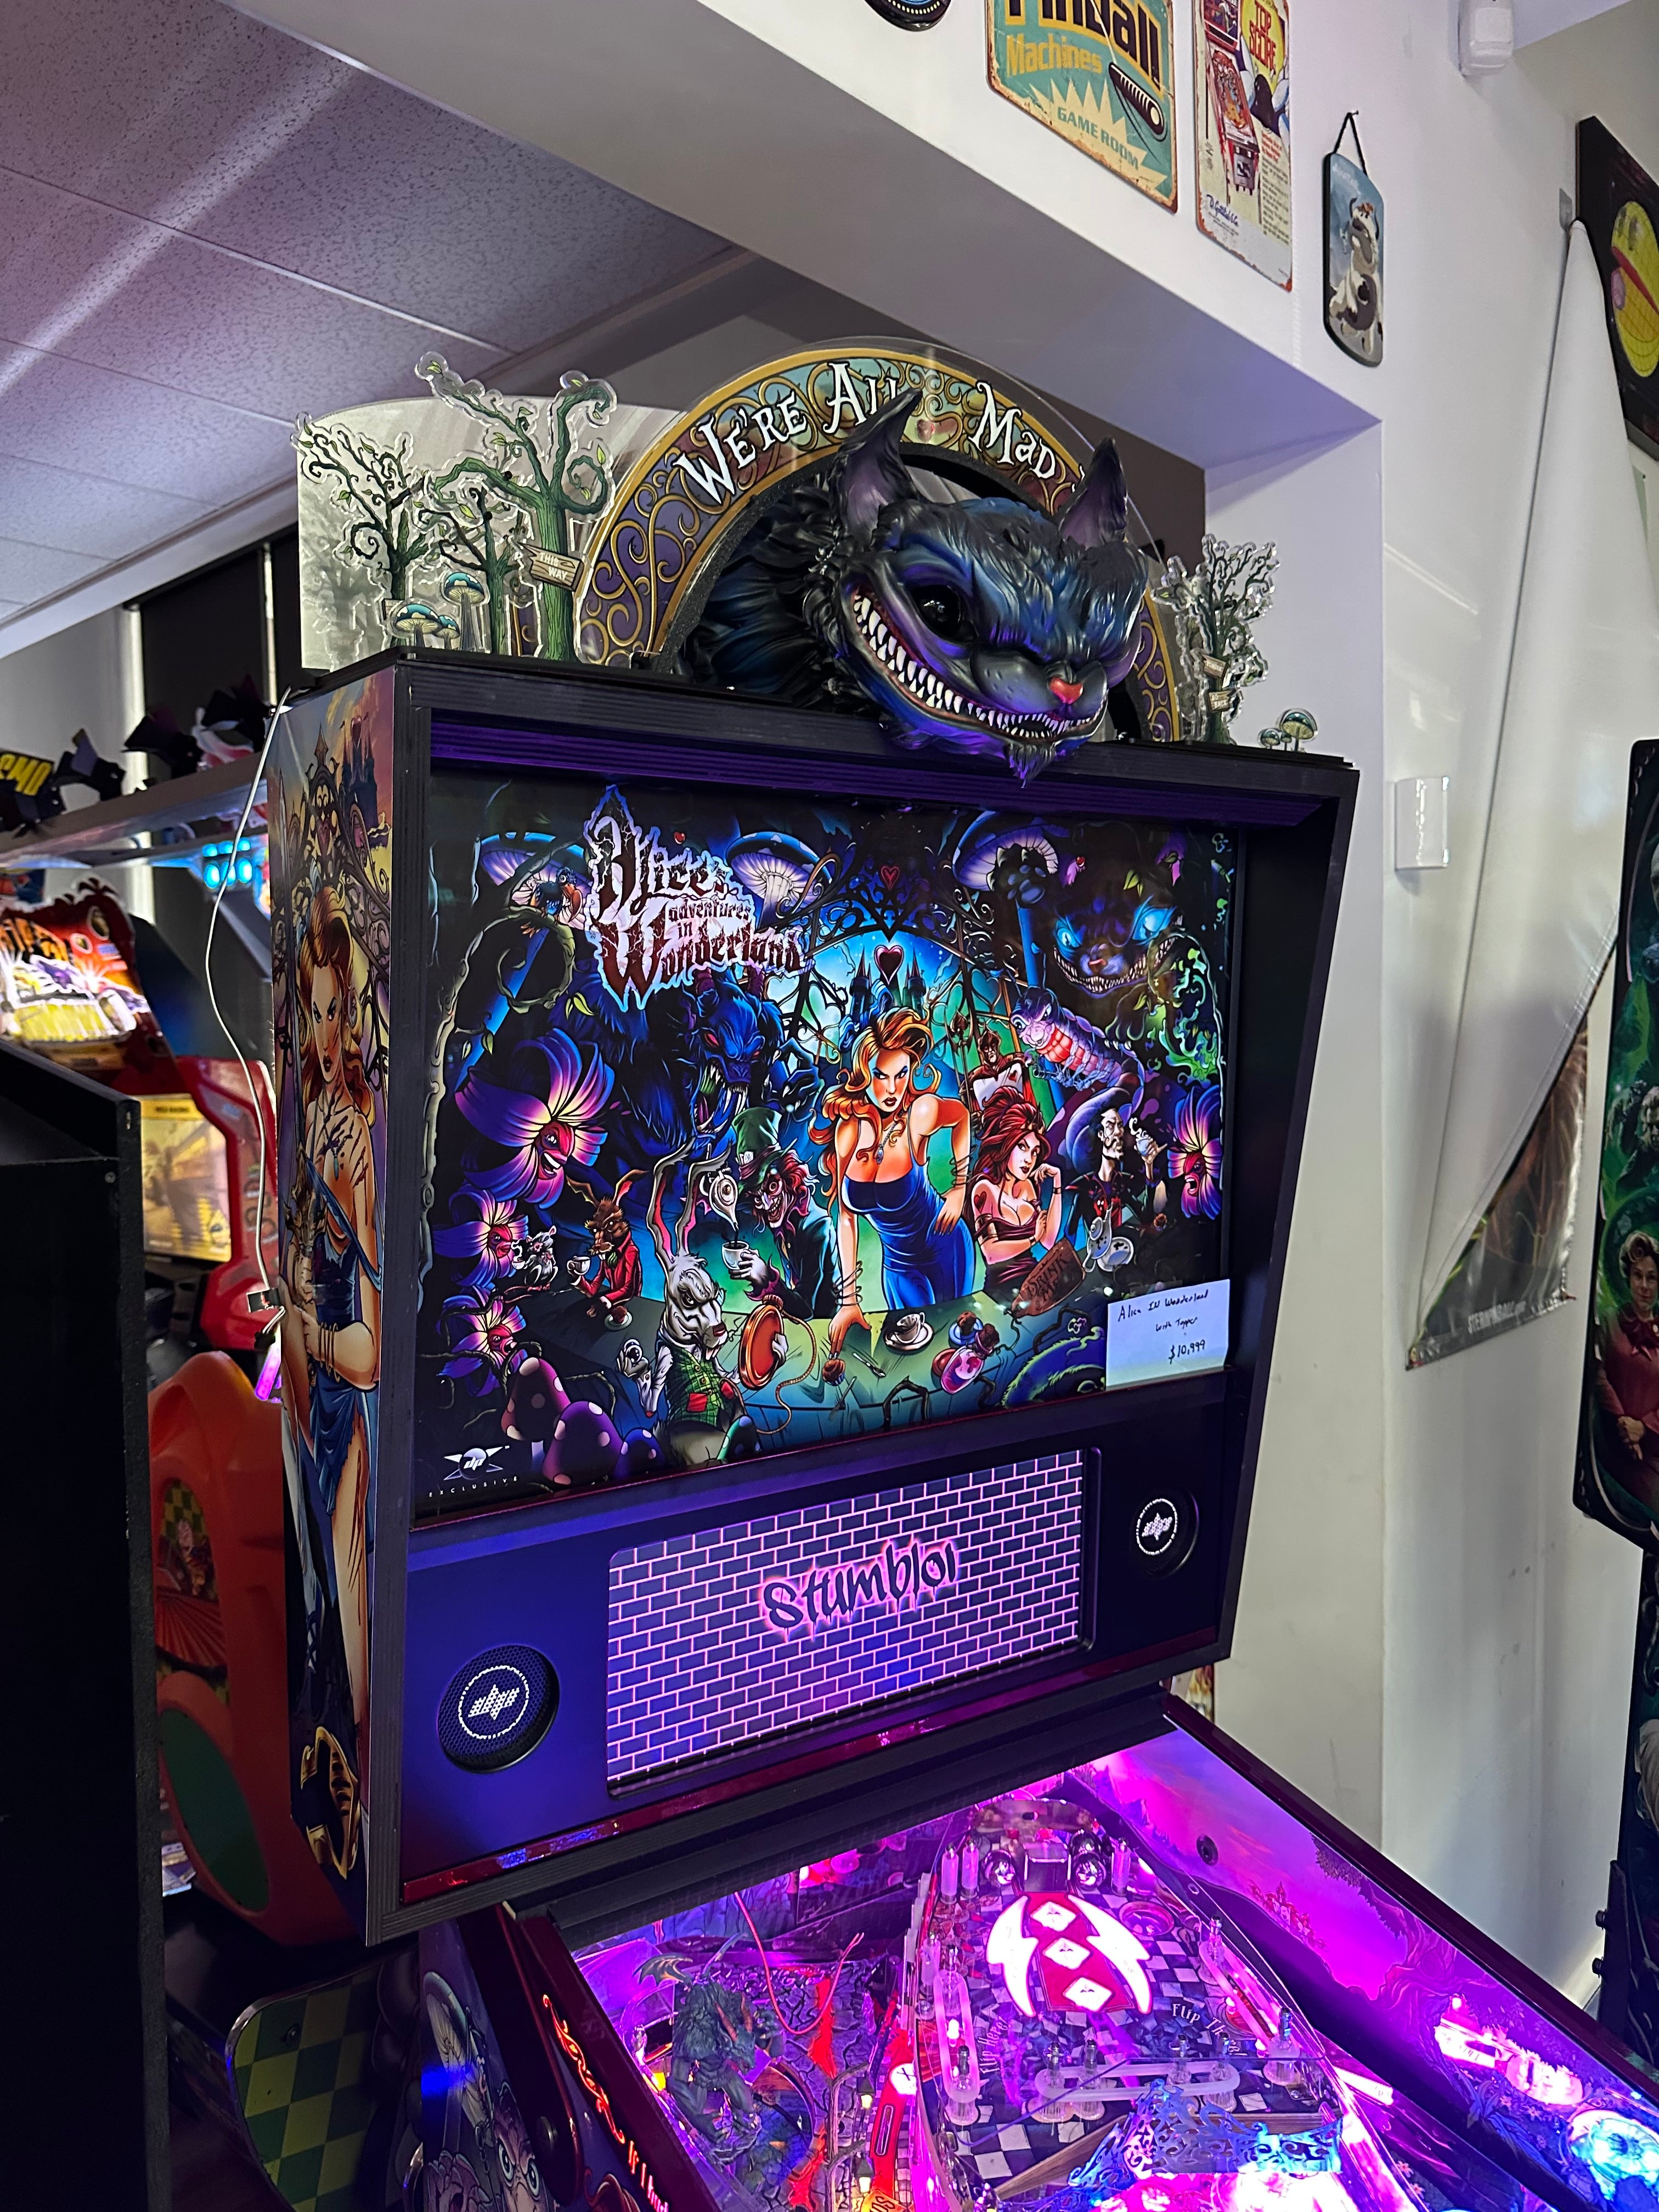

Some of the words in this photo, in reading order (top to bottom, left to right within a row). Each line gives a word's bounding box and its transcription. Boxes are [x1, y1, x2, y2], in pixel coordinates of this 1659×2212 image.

[1006, 33, 1102, 78] Machines
[1057, 106, 1098, 140] GAME
[1101, 128, 1139, 171] ROOM
[539, 552, 560, 567] THIS
[549, 566, 569, 580] WAY
[677, 921, 694, 939] in
[592, 907, 803, 1001] Wonderland
[1168, 1339, 1206, 1364] $10,999
[429, 1476, 518, 1498] EXCLUSIVE
[1172, 2003, 1201, 2023] Flip
[977, 2015, 1008, 2047] Here!
[979, 2050, 1001, 2074] Flip
